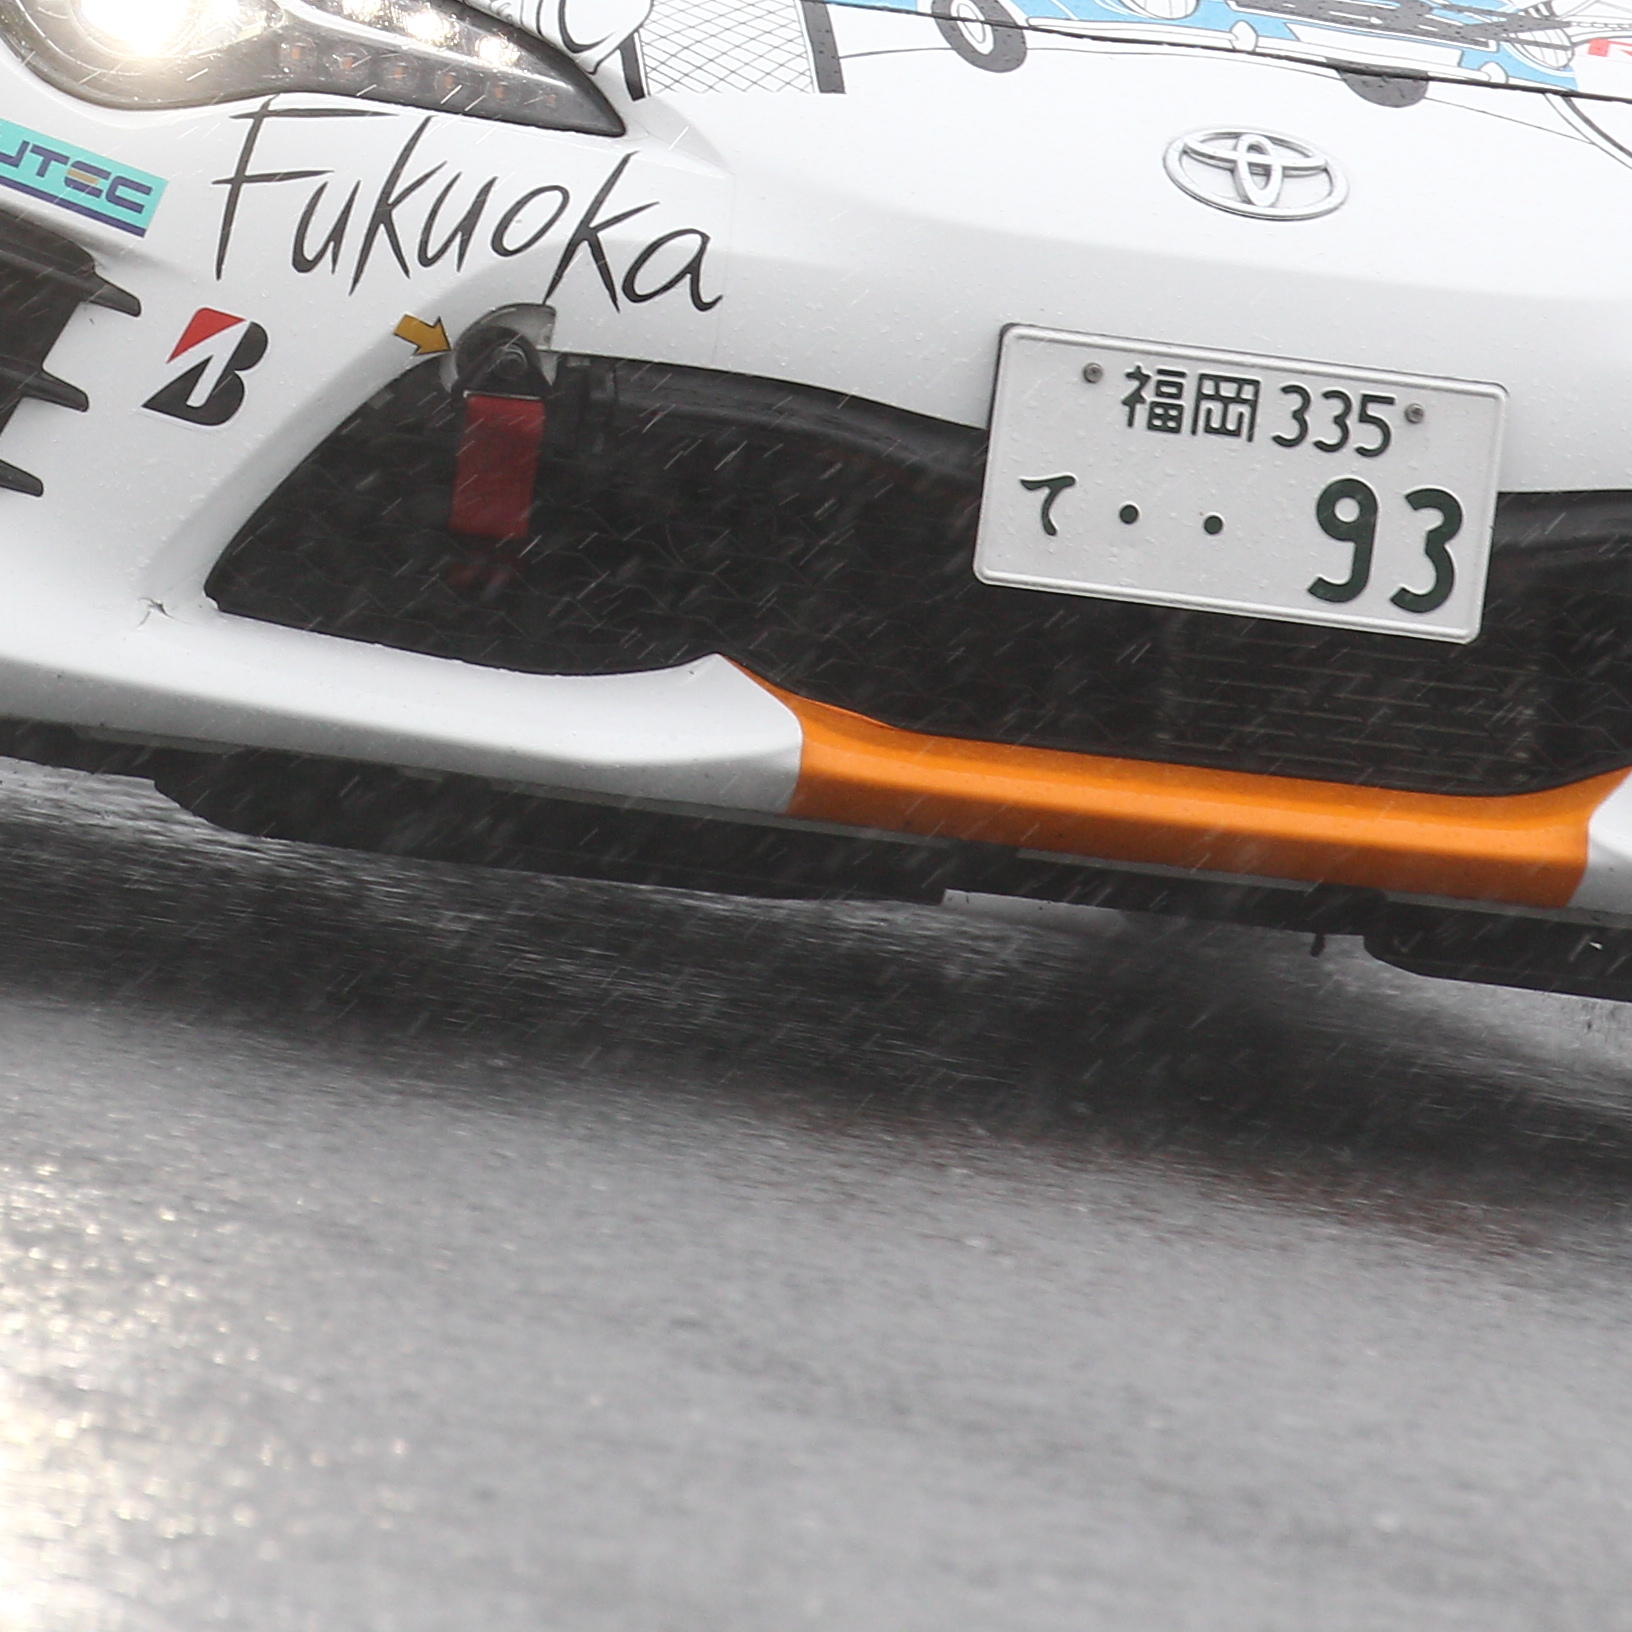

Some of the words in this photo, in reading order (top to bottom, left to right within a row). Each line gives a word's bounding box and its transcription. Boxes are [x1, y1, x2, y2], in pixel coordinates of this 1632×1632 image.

[212, 94, 723, 313] Fukuoka
[1121, 365, 1261, 442] 福岡
[1271, 383, 1396, 457] 335
[1020, 473, 1076, 536] て
[1307, 477, 1464, 614] 93
